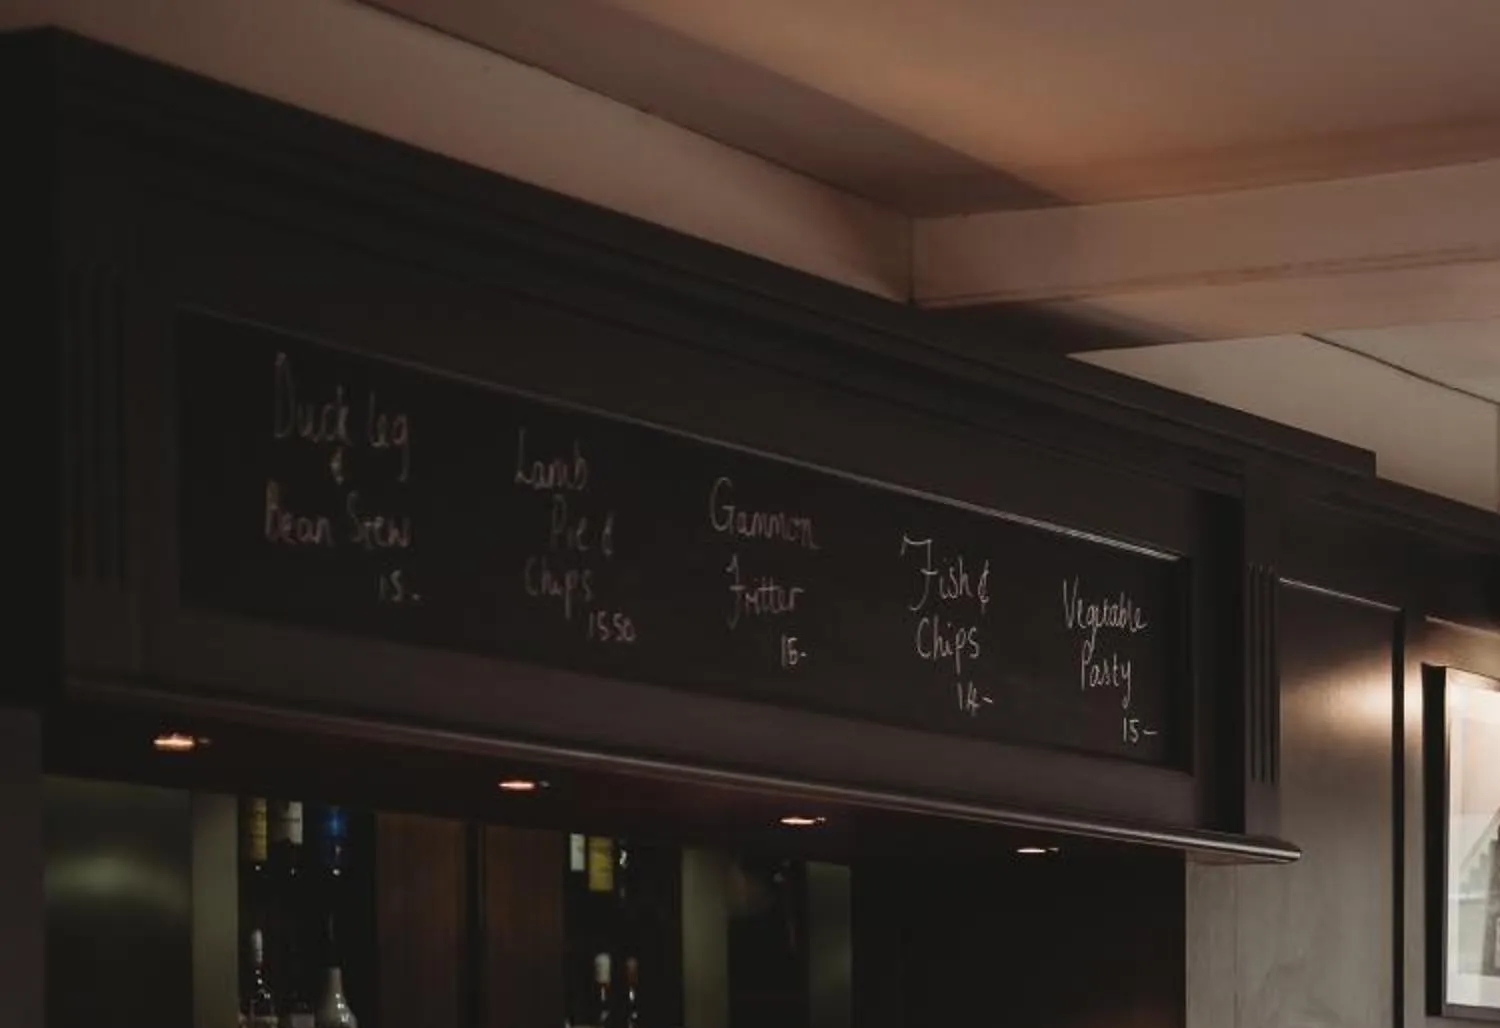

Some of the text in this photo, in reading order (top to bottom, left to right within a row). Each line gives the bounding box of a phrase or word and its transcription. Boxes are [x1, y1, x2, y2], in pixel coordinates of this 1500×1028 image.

[273, 351, 352, 447] Duck
[514, 429, 588, 491] Lamb
[264, 480, 412, 550] Bean Stew
[551, 495, 589, 552] Pie
[709, 476, 821, 550] Gammon
[525, 556, 594, 619] Chips
[725, 554, 805, 630] Fritter
[901, 533, 969, 612] Fish
[916, 616, 981, 675] Chips
[1063, 576, 1147, 650] Vegetable
[1081, 638, 1132, 709] Pasty
